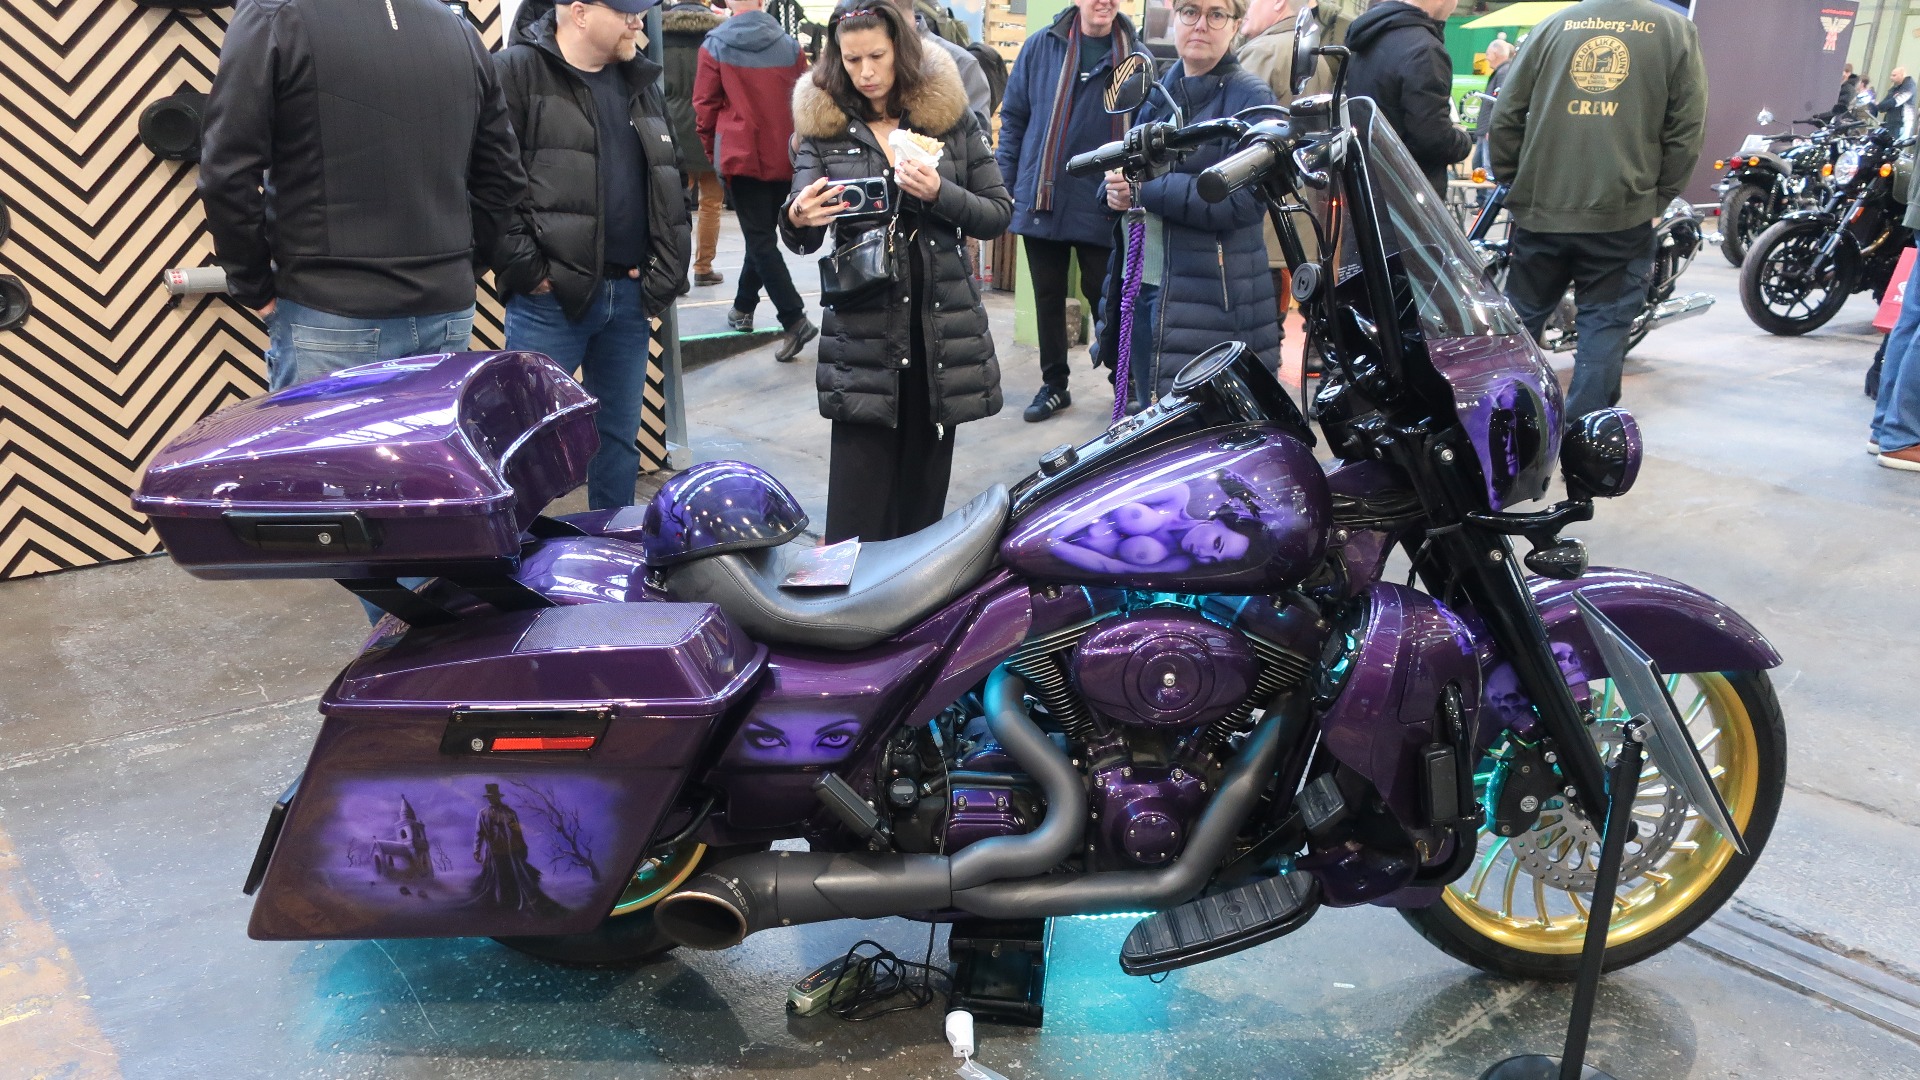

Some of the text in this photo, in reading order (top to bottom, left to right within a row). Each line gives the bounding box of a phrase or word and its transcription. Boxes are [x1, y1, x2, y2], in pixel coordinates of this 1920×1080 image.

[385, 0, 398, 30] TORRAD
[1563, 17, 1655, 33] Buchberg-MC
[1576, 43, 1592, 67] MADE
[1595, 38, 1615, 47] LIKE
[1618, 50, 1627, 69] GUN
[1567, 99, 1619, 117] CREW
